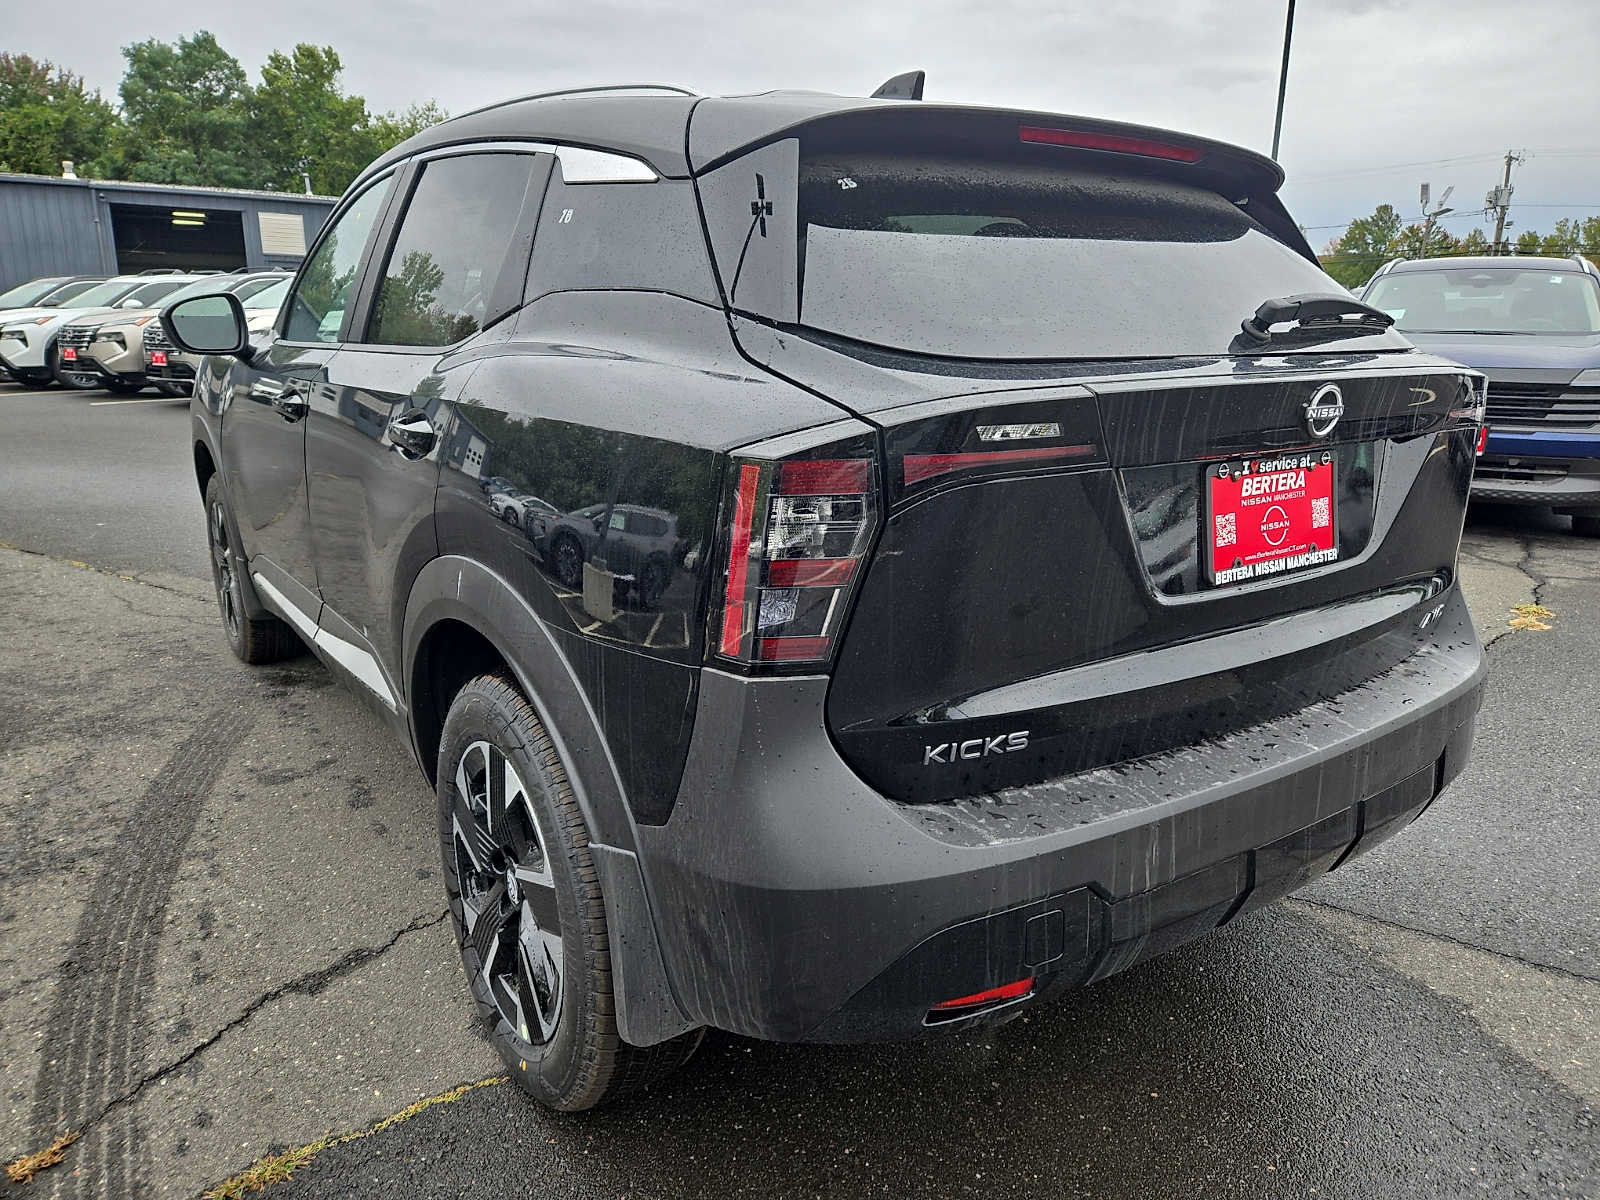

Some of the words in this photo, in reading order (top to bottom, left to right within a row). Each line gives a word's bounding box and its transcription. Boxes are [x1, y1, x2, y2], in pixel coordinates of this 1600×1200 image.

[1307, 406, 1345, 419] NISSAN
[1242, 461, 1250, 475] I
[1259, 456, 1298, 473] service
[1241, 470, 1306, 497] BERTERA
[1241, 495, 1272, 507] NISSAN
[1274, 490, 1306, 502] MANCHESTER
[1260, 519, 1290, 532] NISSAN
[1215, 565, 1254, 586] BERTERA
[1255, 556, 1286, 577] NISSAN
[1286, 547, 1338, 570] MANCHESTER
[923, 730, 1030, 766] KICKS
